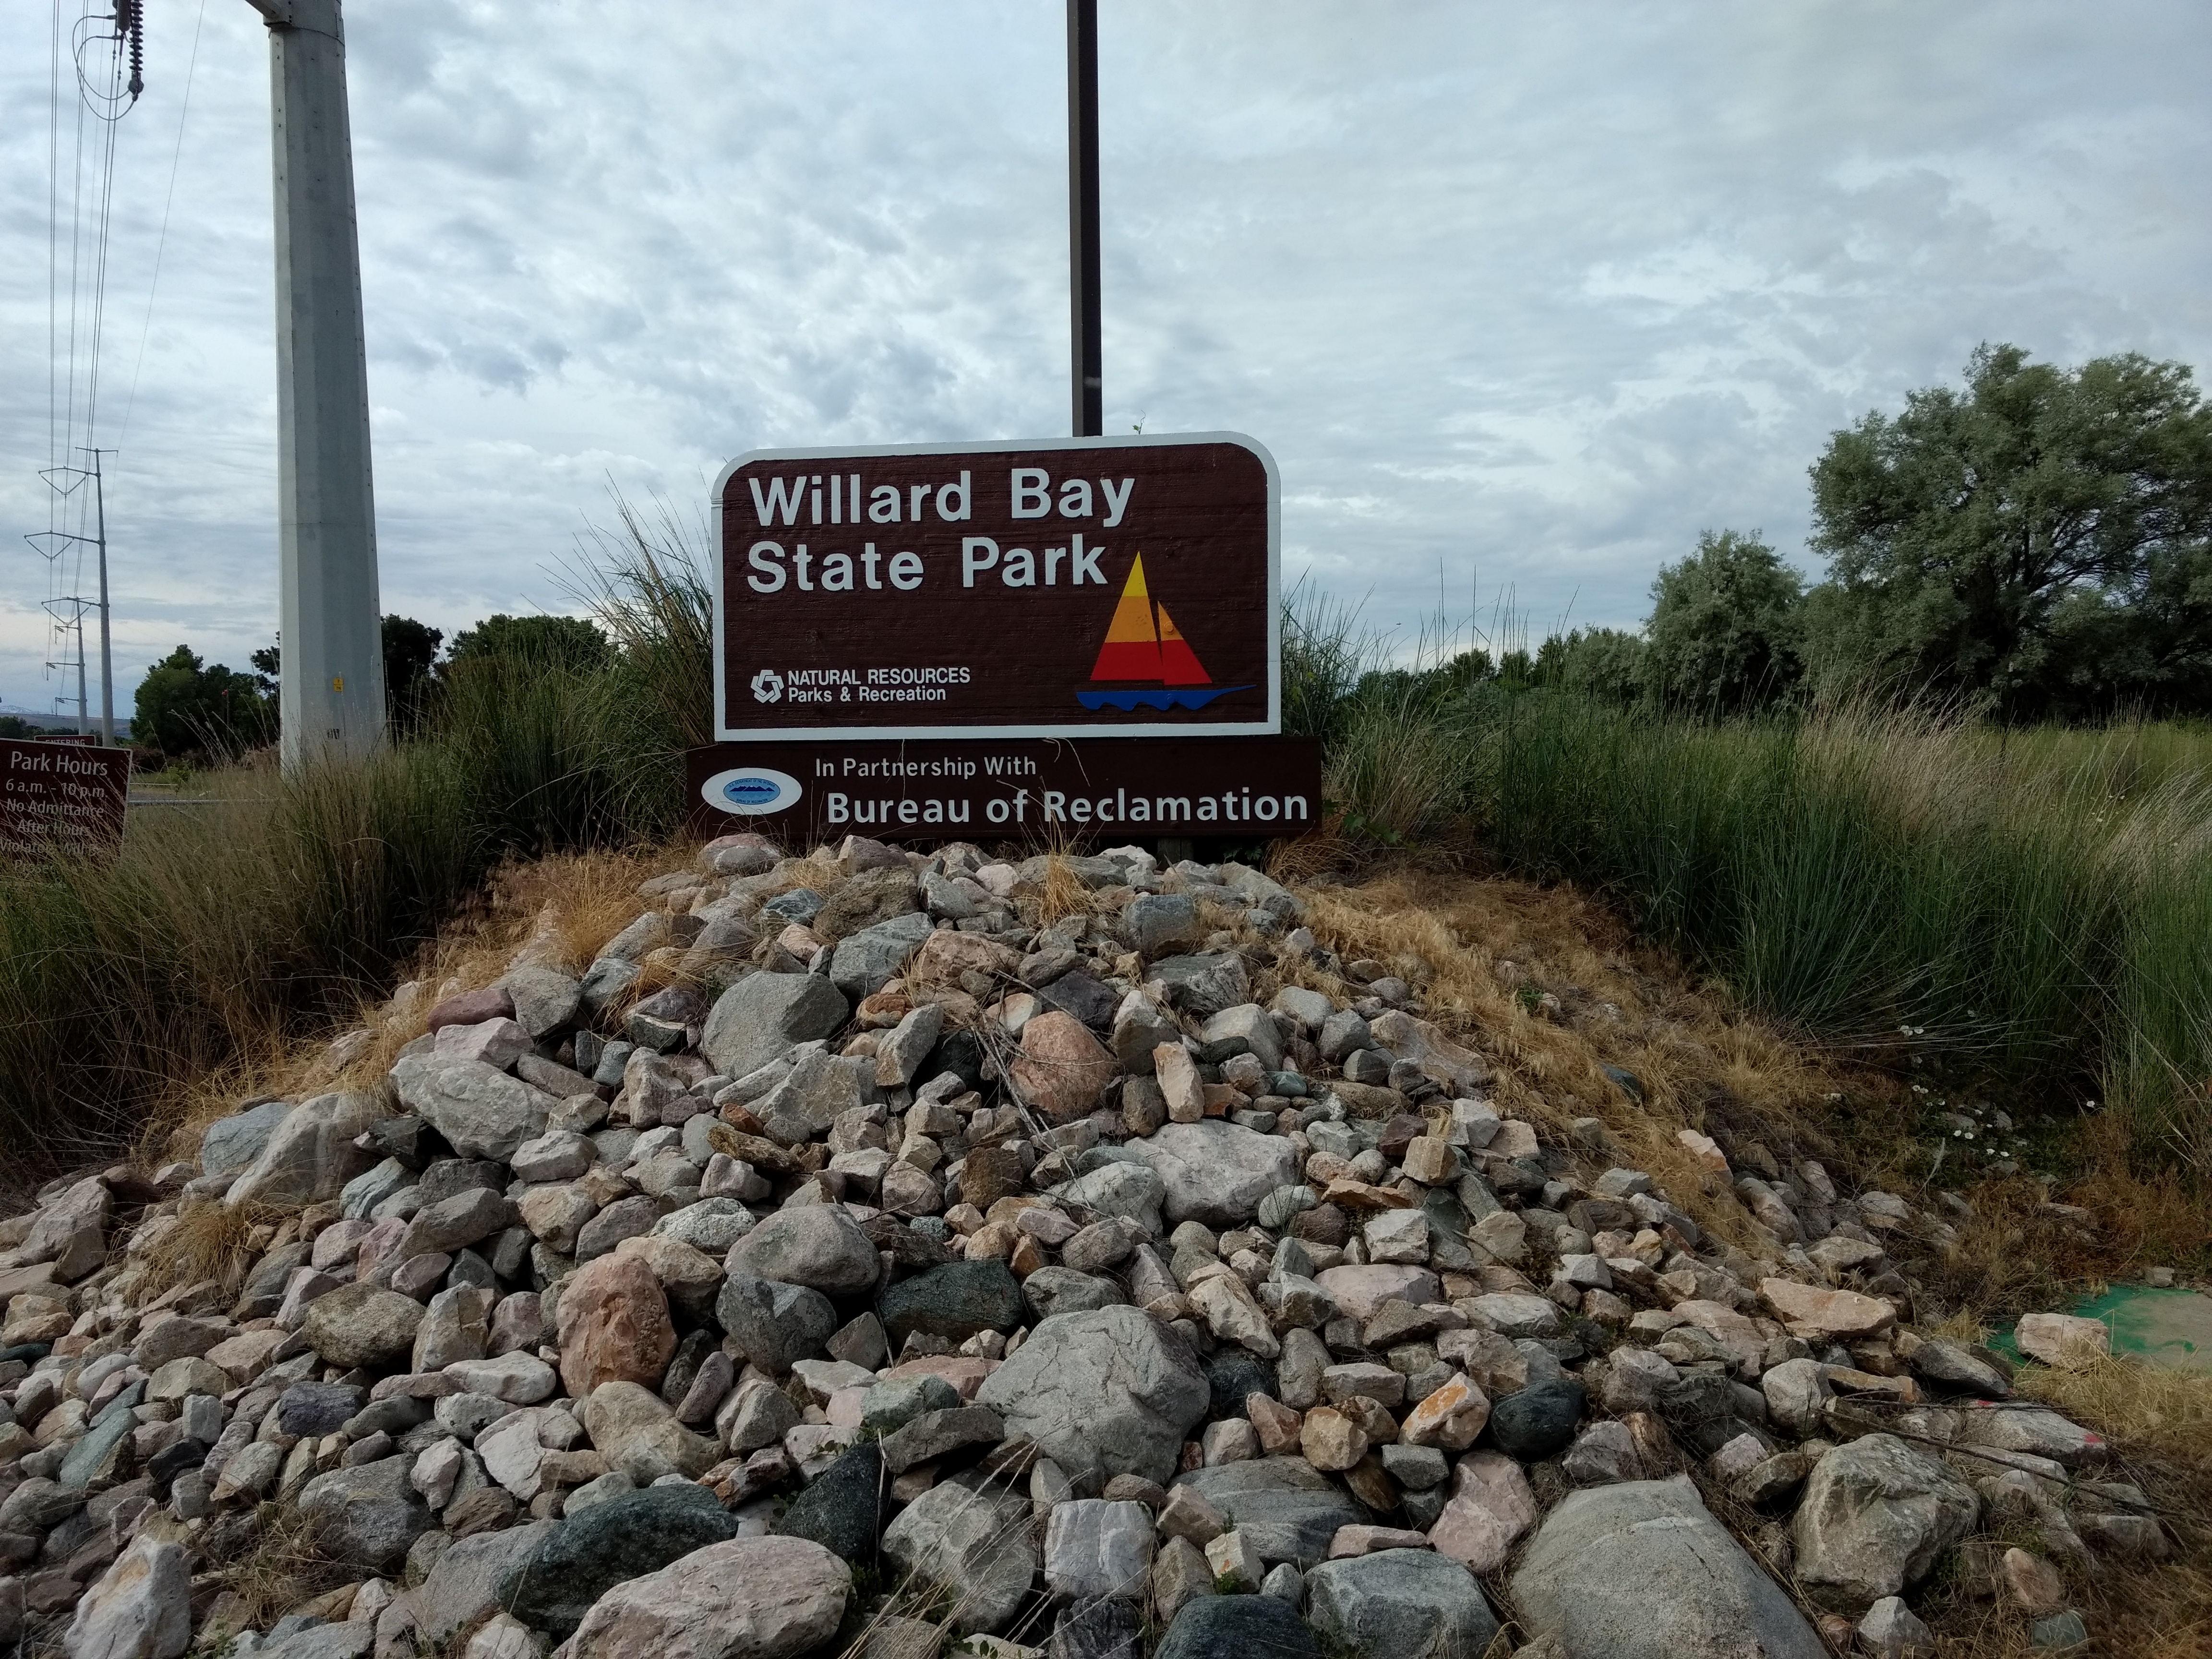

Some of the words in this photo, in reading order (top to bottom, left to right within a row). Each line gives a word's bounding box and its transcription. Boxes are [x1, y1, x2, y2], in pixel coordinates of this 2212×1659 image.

[748, 470, 971, 527] Willard
[1011, 468, 1135, 528] Bay
[747, 541, 924, 593] State
[962, 533, 1109, 588] Park
[788, 669, 861, 685] NATURAL
[867, 667, 971, 685] RESOURCES
[788, 686, 832, 703] Parks
[840, 686, 852, 702] &
[859, 685, 946, 702] Recreation
[11, 751, 51, 772] Park
[56, 754, 108, 777] Hours
[816, 758, 835, 777] In
[843, 757, 976, 780] Partnership
[984, 756, 1036, 776] With
[6, 778, 14, 791] 6
[17, 781, 47, 794] a.m.
[61, 782, 77, 795] 10
[80, 786, 108, 800] p.m.
[7, 798, 25, 813] No
[28, 799, 104, 818] Admittance
[827, 792, 970, 824] Bureau
[986, 789, 1028, 823] of
[1044, 786, 1308, 823] Reclamation
[17, 819, 50, 834] After
